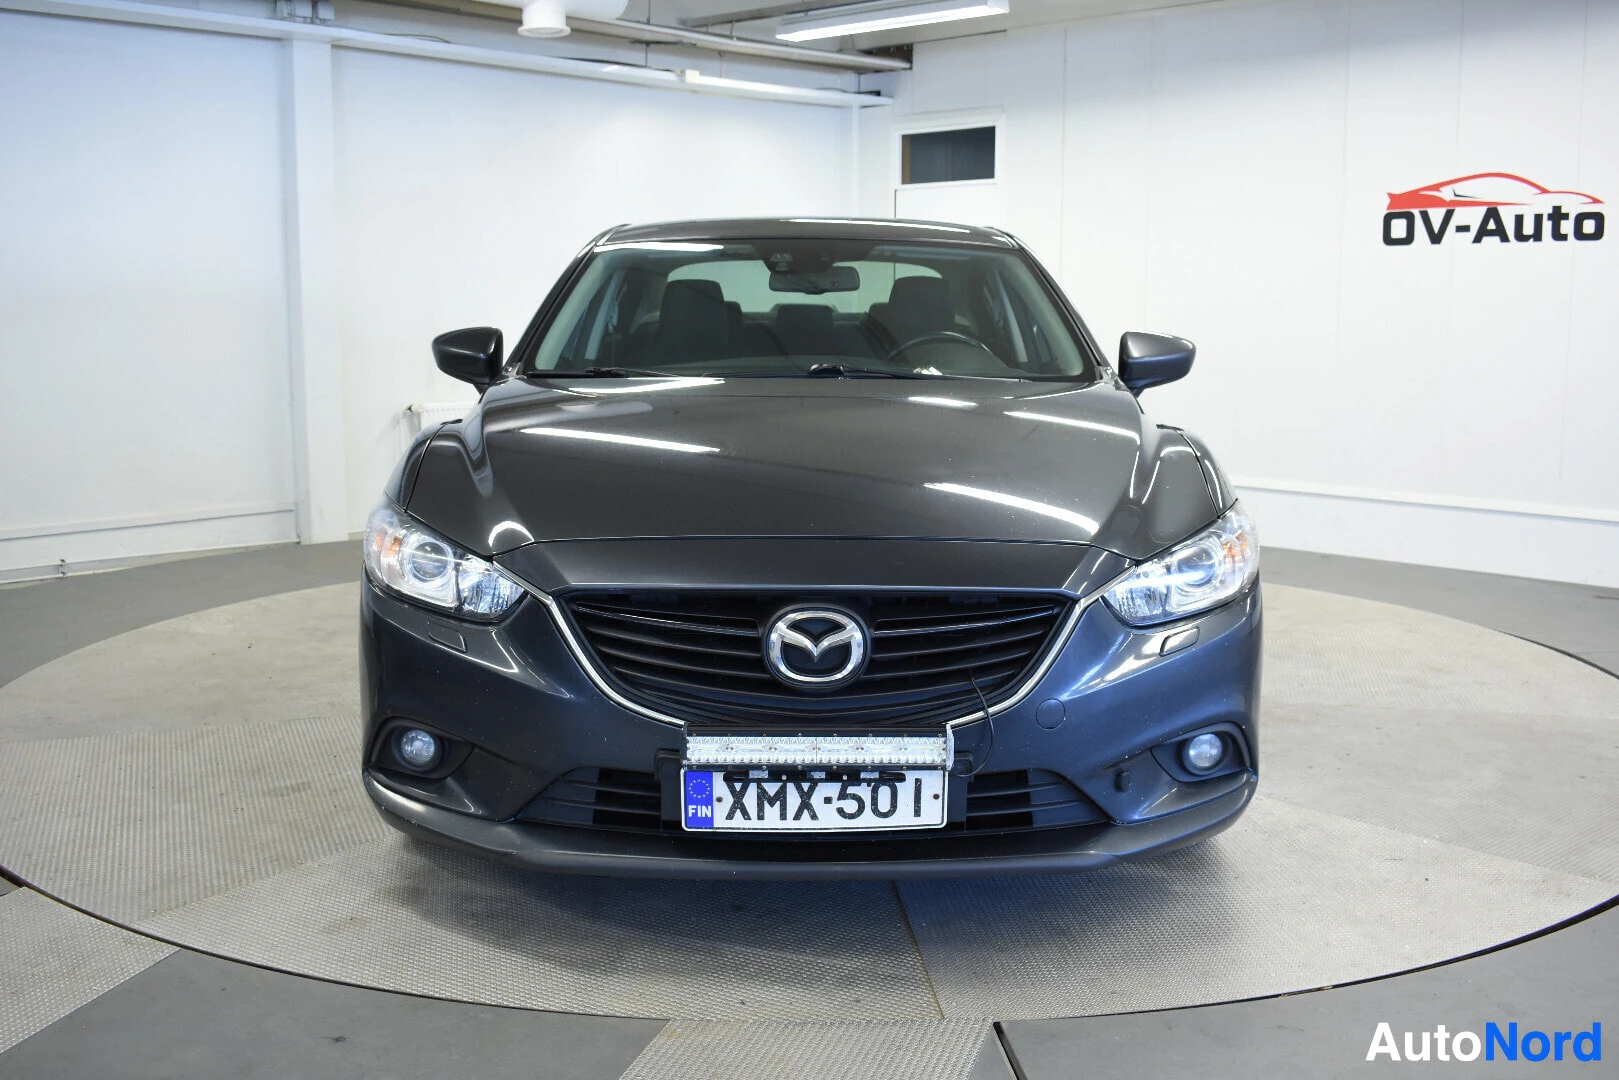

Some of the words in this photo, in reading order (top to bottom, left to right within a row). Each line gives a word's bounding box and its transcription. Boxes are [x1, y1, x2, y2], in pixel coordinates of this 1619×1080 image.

[1383, 205, 1605, 246] OV-Auto
[688, 804, 712, 818] FIN
[725, 778, 922, 821] XMX-501
